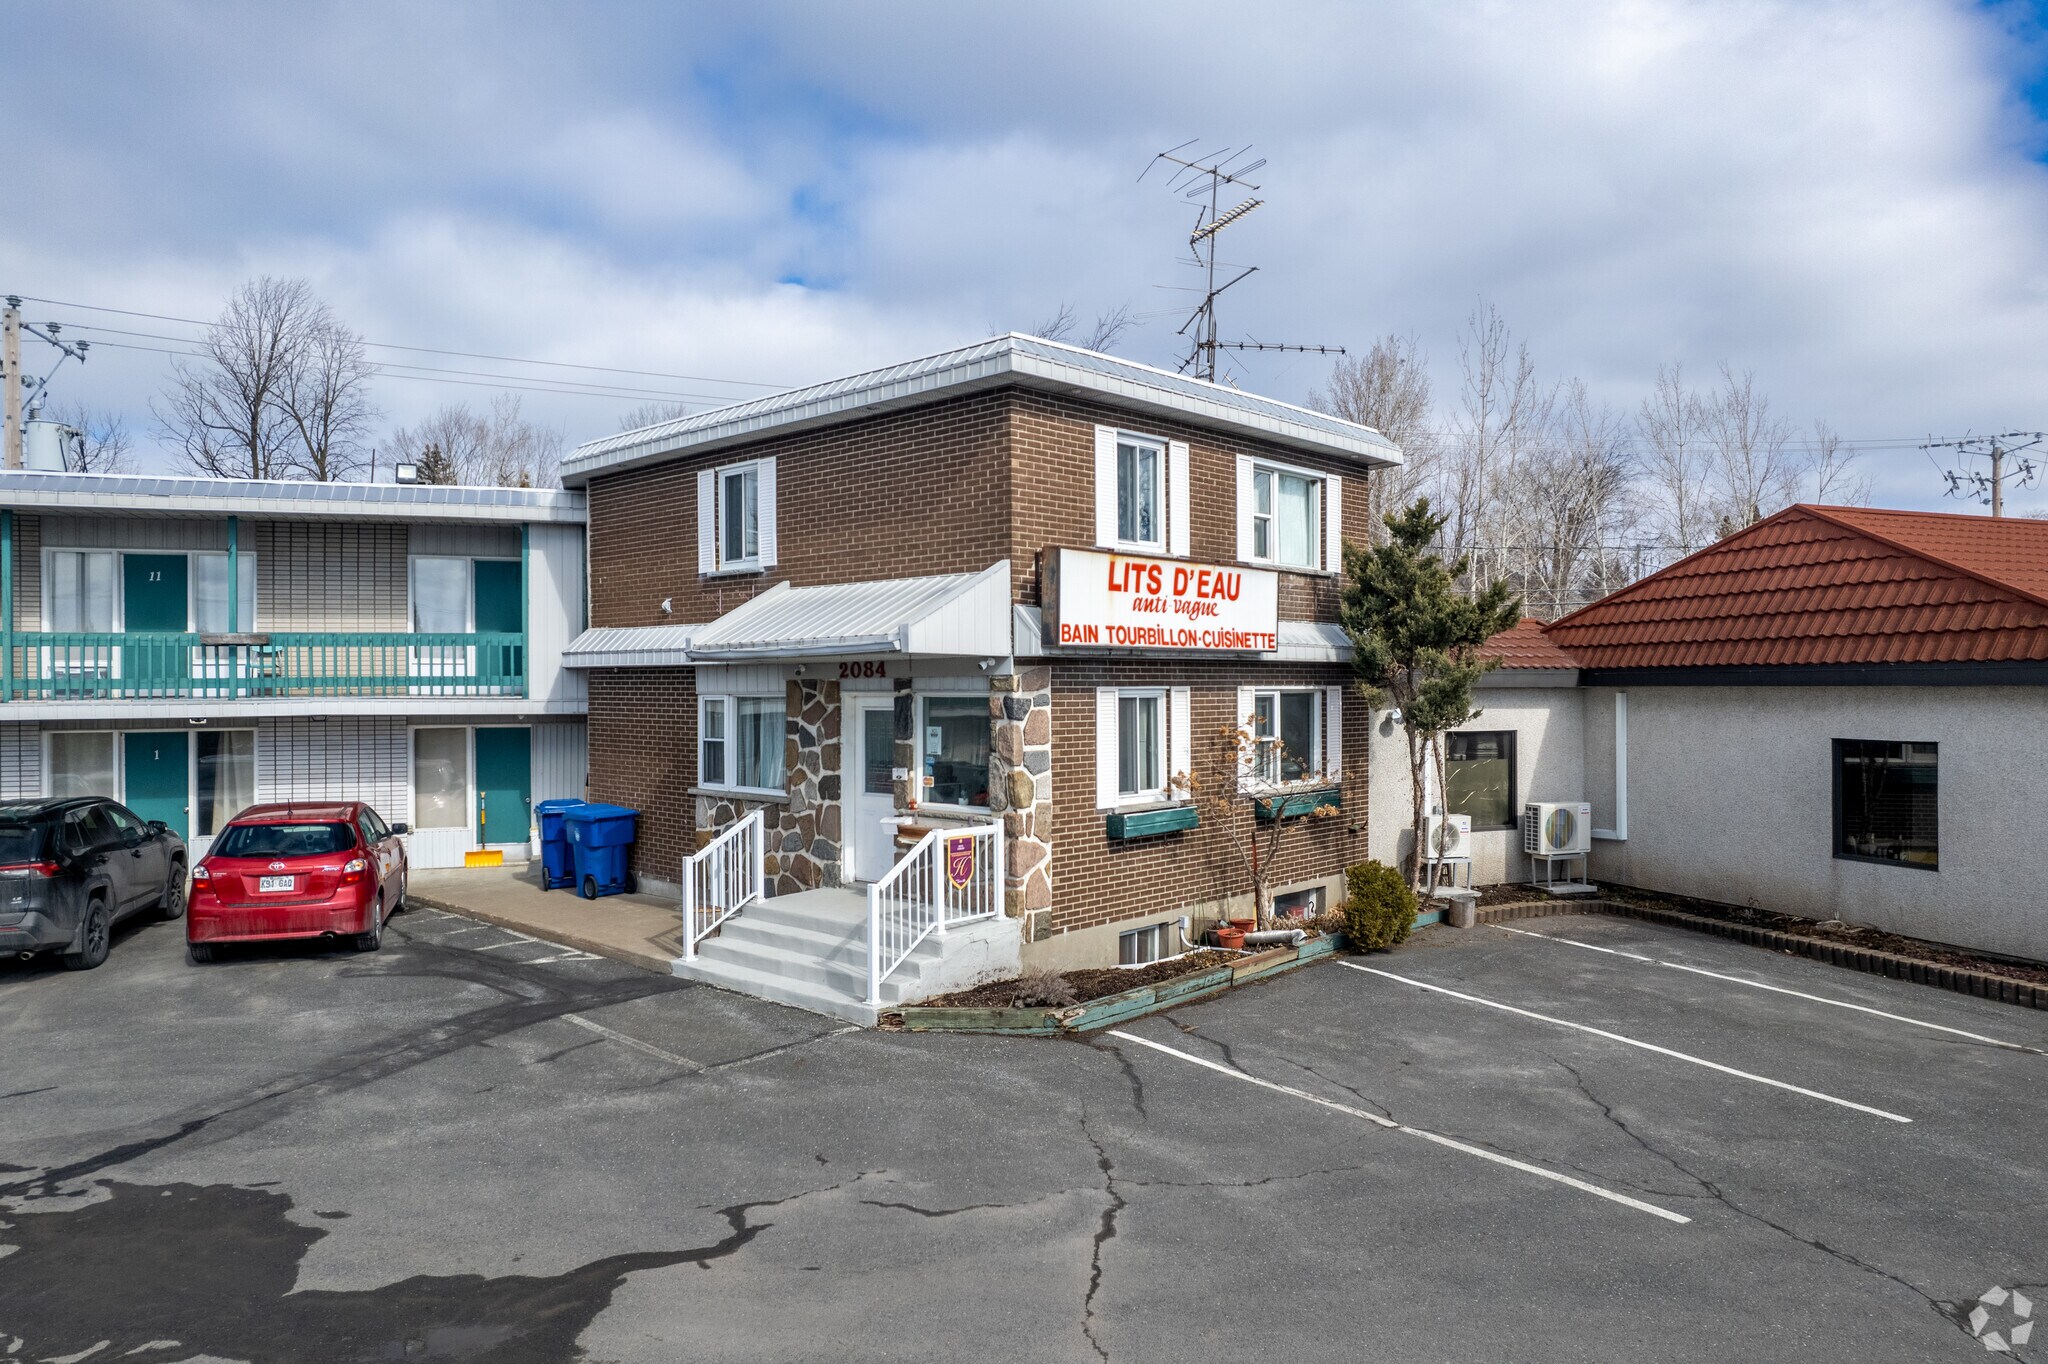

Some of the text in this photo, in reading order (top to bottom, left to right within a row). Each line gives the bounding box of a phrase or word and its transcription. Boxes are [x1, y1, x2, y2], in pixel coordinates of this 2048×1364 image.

[149, 570, 161, 581] 11
[1108, 561, 1241, 601] LITS D'EAU
[1061, 623, 1099, 643] BAIN
[839, 660, 887, 679] 2084
[154, 749, 160, 760] 1
